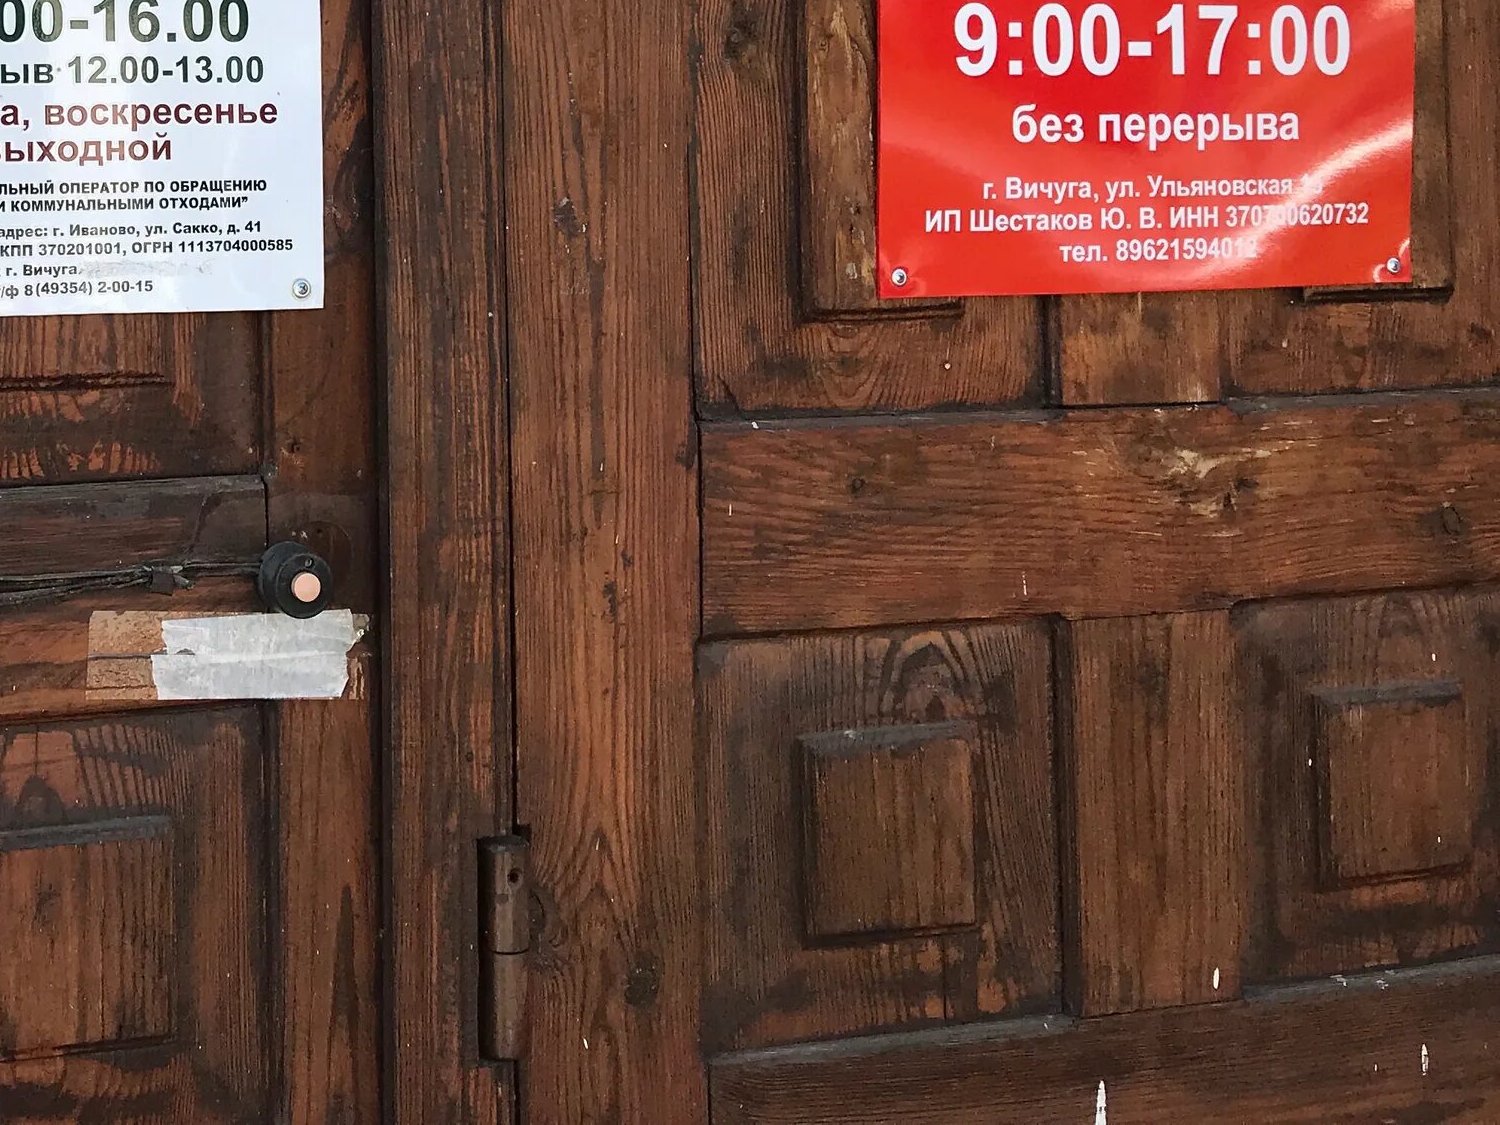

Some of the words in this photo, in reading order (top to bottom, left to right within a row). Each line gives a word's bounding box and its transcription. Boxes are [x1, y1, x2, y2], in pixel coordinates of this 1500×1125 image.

[954, 1, 1350, 76] 9:00-17:00
[68, 56, 263, 83] 12.00-13.00
[45, 103, 277, 132] воскресенье
[1012, 104, 1084, 143] без
[1099, 113, 1299, 151] перерыва
[59, 181, 139, 194] ОПЕРАТОР
[144, 181, 165, 193] ПО
[170, 180, 267, 194] ОБРАЩЕНИЮ
[983, 183, 996, 199] г.
[1006, 177, 1099, 204] Вичуга,
[1106, 181, 1140, 203] ул.
[1147, 175, 1293, 199] Ульяновская
[11, 198, 154, 212] КОММУНАЛЬНЫМИ
[926, 210, 961, 232] ИП
[970, 209, 1092, 231] Шестаков
[1101, 207, 1131, 229] Ю.
[1140, 207, 1162, 229] В.
[1170, 206, 1218, 228] ИНН
[53, 228, 64, 236] г.
[70, 224, 140, 237] Иваново,
[145, 226, 167, 237] ул.
[173, 222, 222, 235] Сакко,
[227, 224, 240, 235] д.
[245, 220, 260, 232] 41
[0, 244, 33, 257] КПП
[38, 242, 126, 256] 370201001,
[132, 241, 173, 253] ОГРН
[179, 239, 293, 253] 1113704000585
[1059, 245, 1107, 262] тел.
[6, 267, 17, 276] г.
[98, 280, 153, 293] 2-00-15
